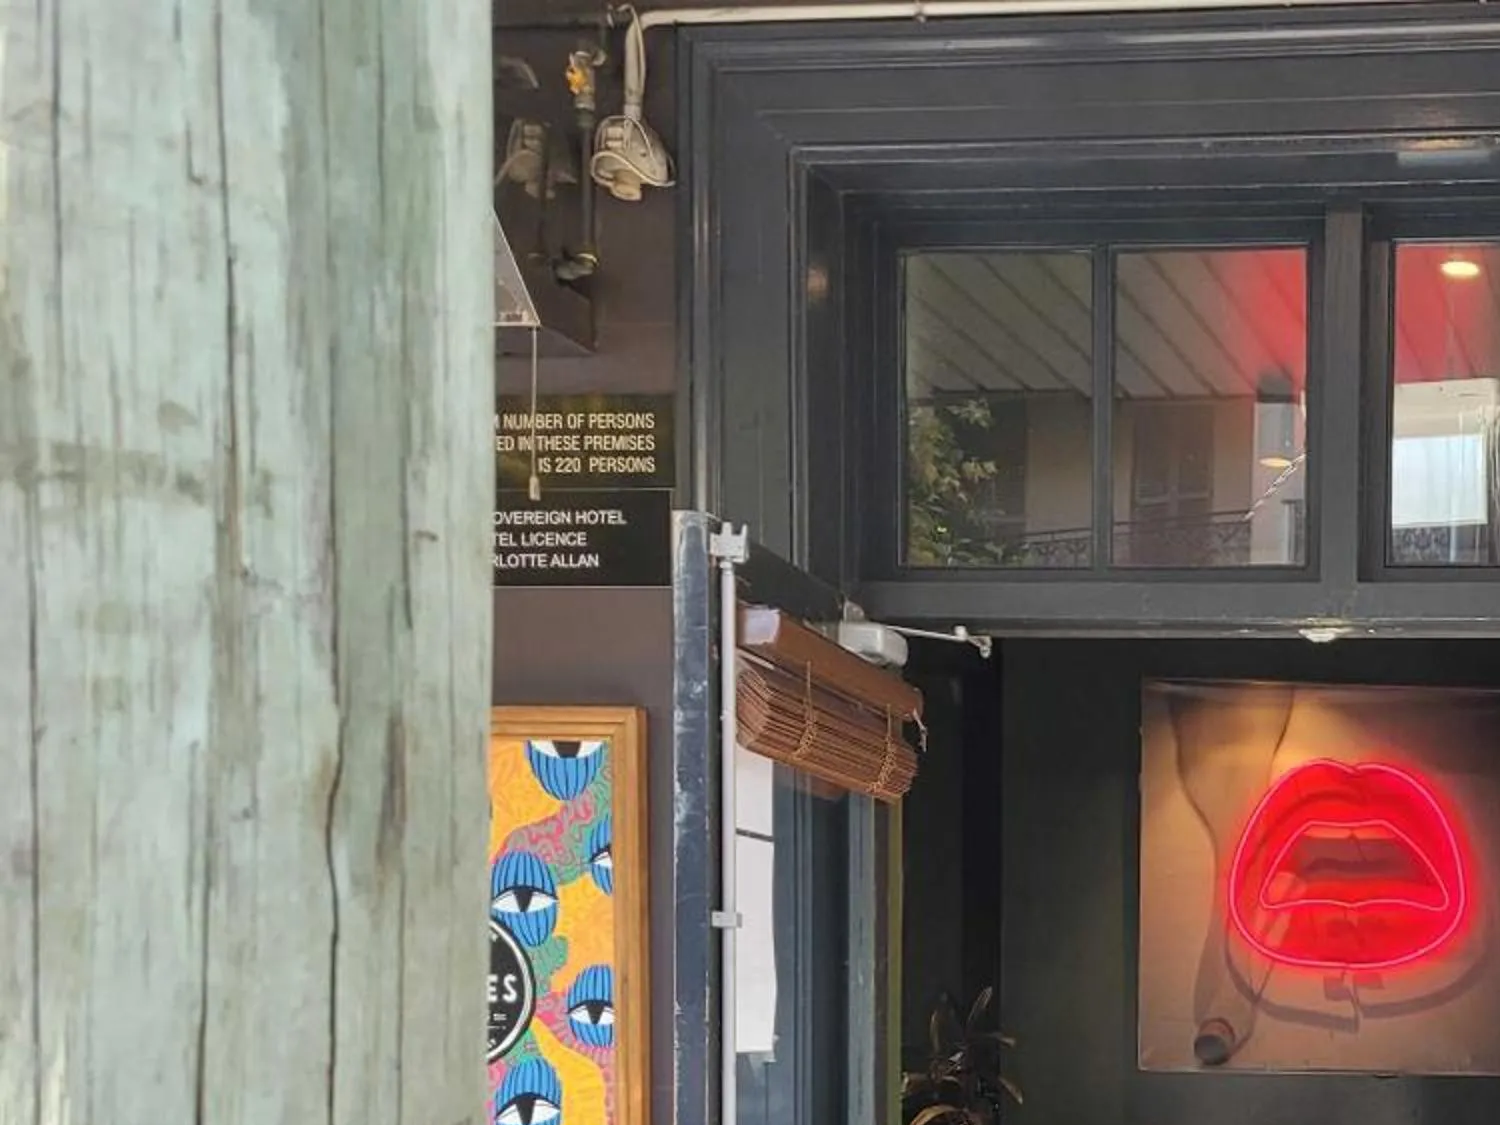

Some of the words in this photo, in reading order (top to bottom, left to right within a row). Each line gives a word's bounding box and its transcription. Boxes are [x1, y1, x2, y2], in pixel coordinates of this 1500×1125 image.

[503, 413, 563, 429] NUMBER
[567, 413, 585, 429] OF
[588, 413, 655, 429] PERSONS
[517, 435, 533, 451] IN
[536, 435, 581, 451] THESE
[583, 434, 656, 451] PREMISES
[538, 457, 551, 473] IS
[555, 457, 581, 473] 220
[589, 457, 656, 473] PERSONS
[575, 510, 627, 525] HOTEL
[521, 532, 587, 547] LICENCE
[550, 553, 600, 568] ALLAN
